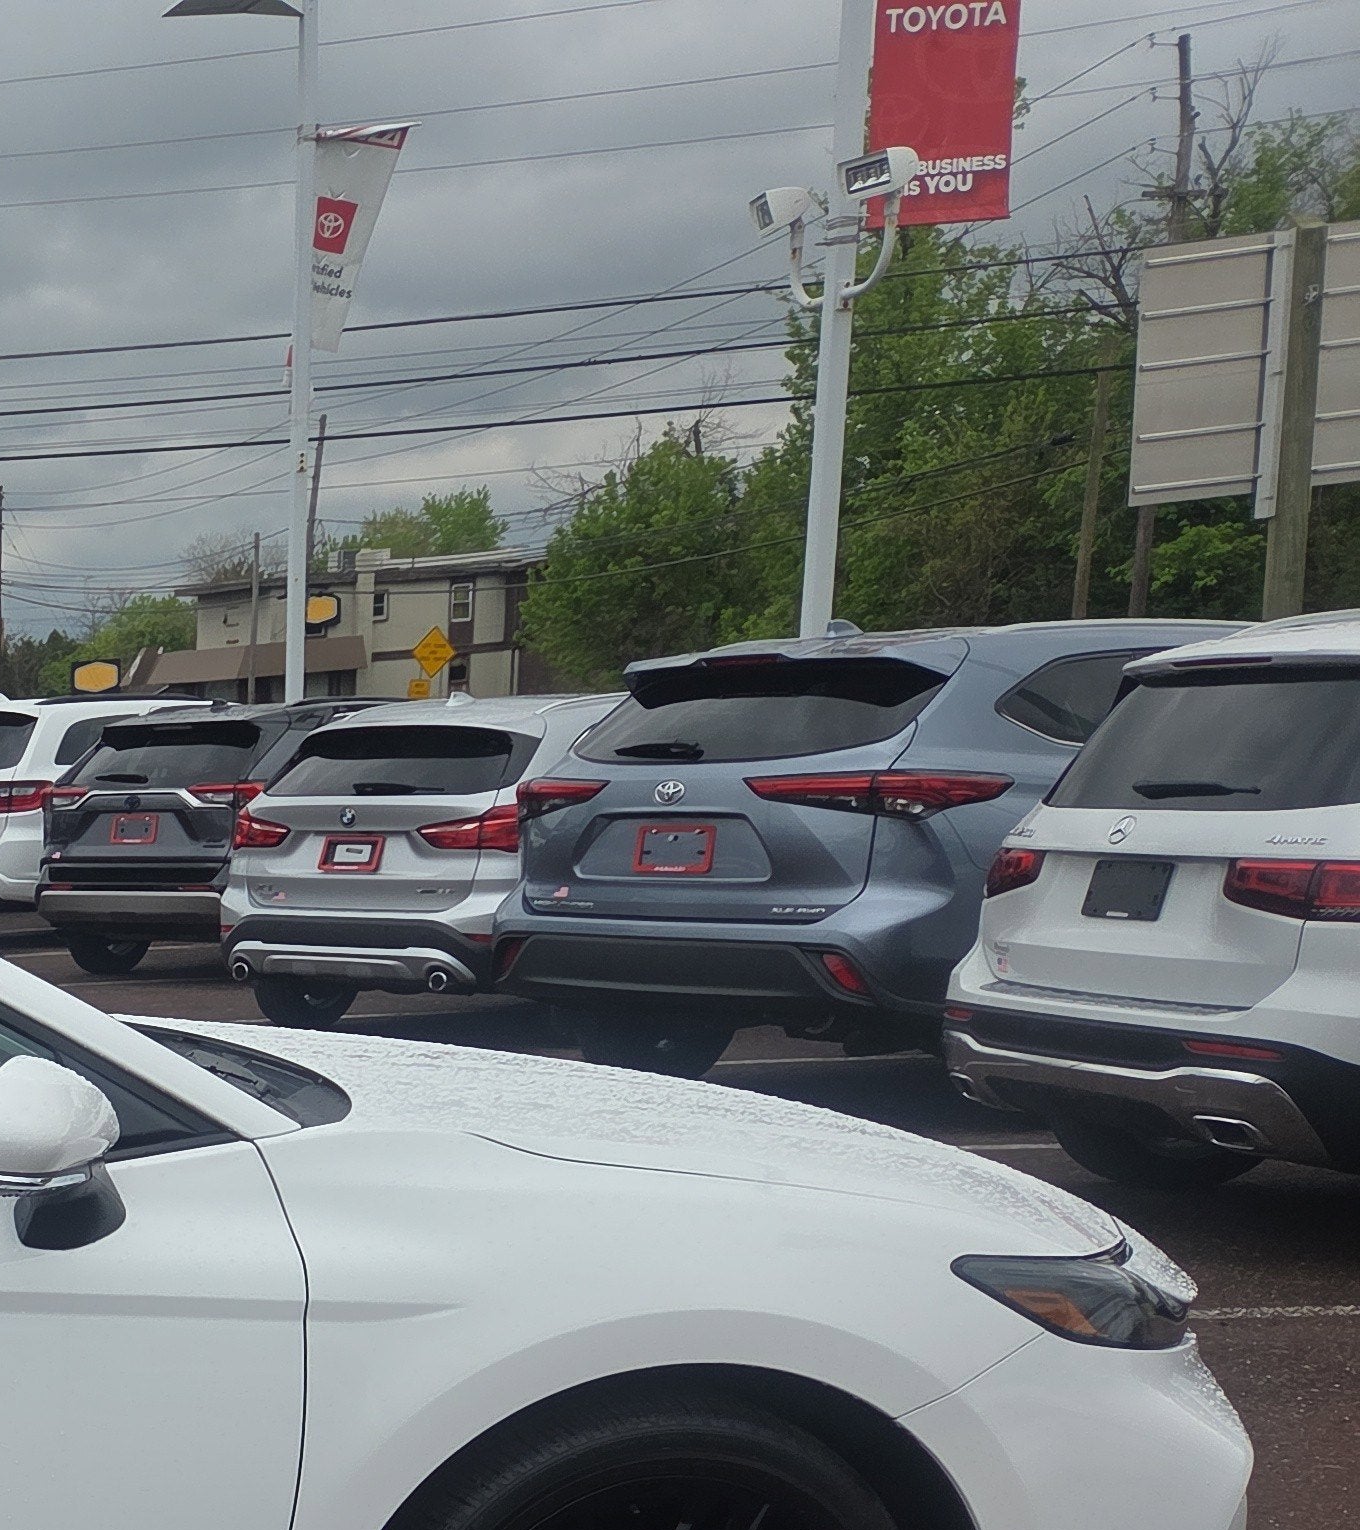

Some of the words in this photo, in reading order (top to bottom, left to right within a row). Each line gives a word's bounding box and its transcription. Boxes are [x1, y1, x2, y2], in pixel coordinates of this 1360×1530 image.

[885, 1, 1007, 33] TOYOTA
[916, 154, 1007, 176] BUSINESS
[902, 180, 921, 196] IS
[924, 173, 973, 195] YOU
